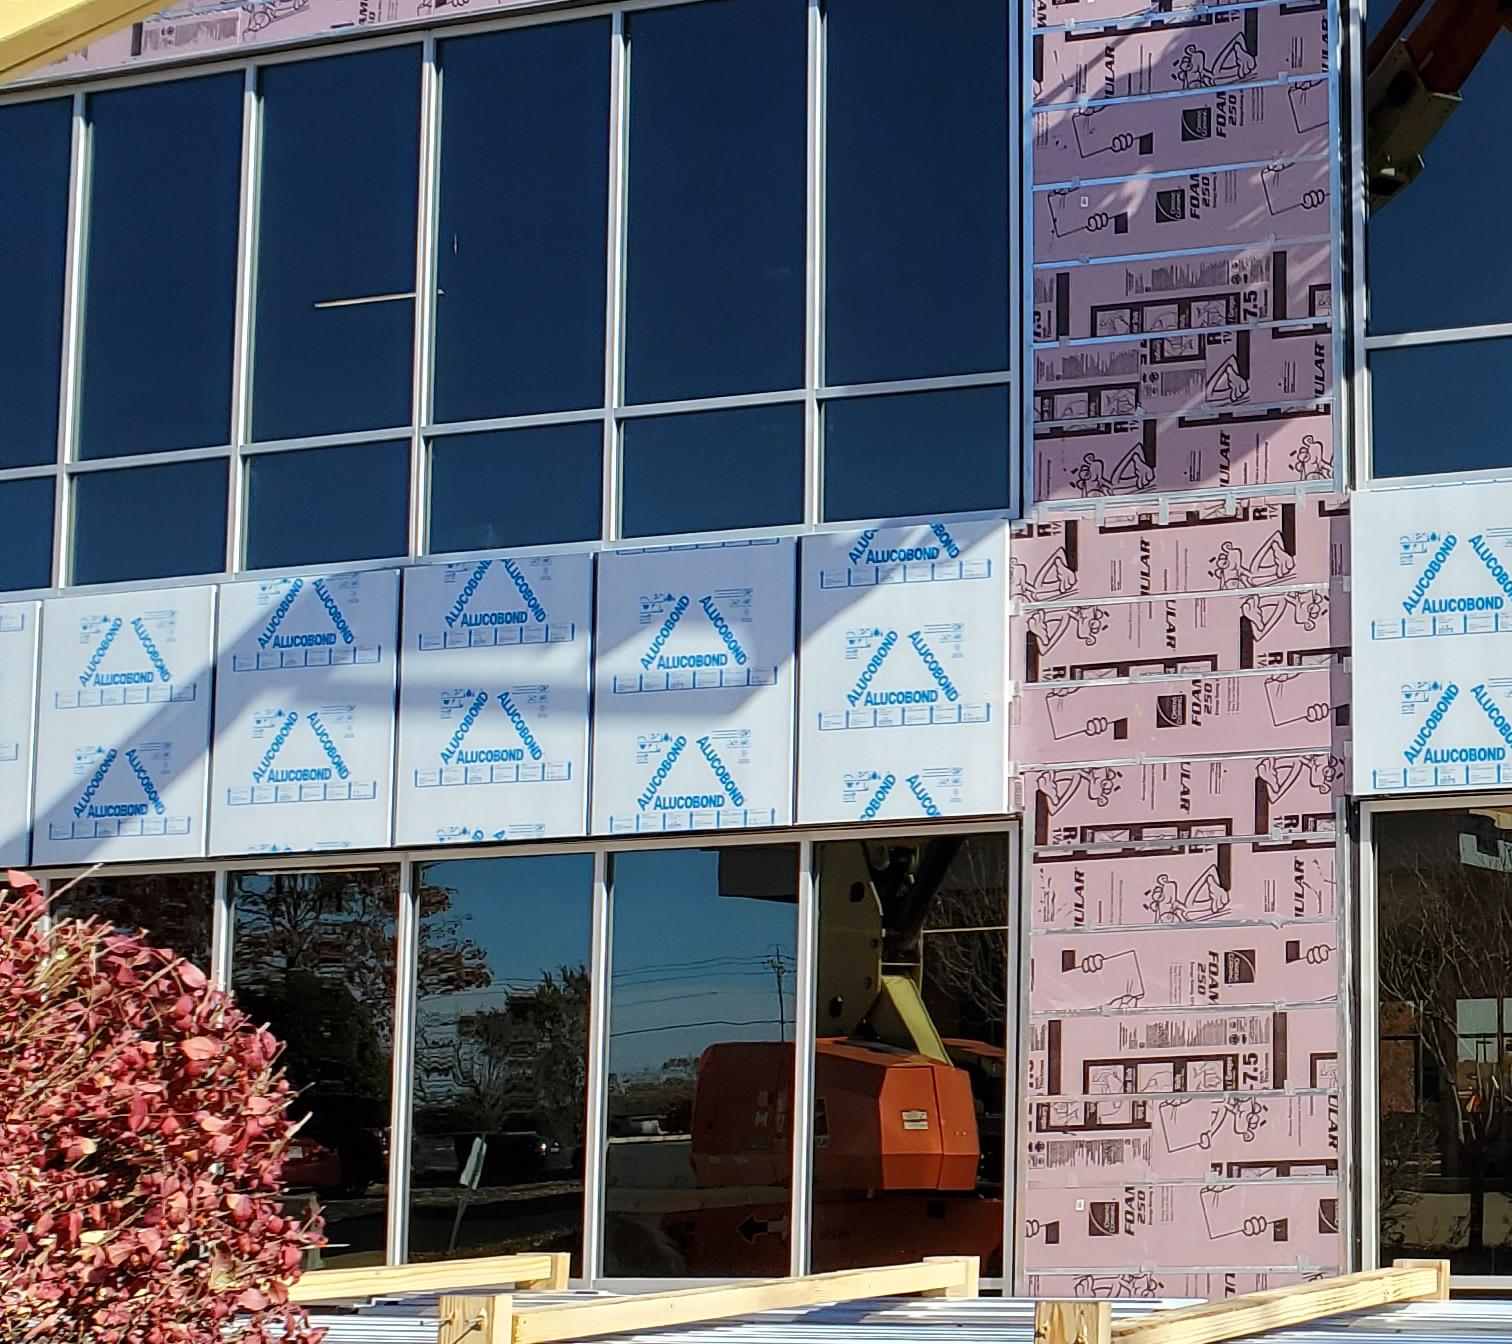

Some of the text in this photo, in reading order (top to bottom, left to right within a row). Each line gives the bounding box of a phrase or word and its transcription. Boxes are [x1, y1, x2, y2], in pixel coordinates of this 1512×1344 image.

[866, 547, 939, 564] ALUCOBOND
[1403, 535, 1456, 614] ALUCOBOND
[258, 582, 301, 649] ALUCOBOND
[313, 579, 354, 644] ALUCOBOND
[461, 611, 527, 627] ALUCOBOND
[641, 594, 690, 669] ALUCOBOND
[699, 595, 746, 665] ALUCOBOND
[1422, 596, 1503, 613] ALUCOBOND
[80, 618, 122, 686] ALUCOBOND
[131, 618, 170, 682] ALUCOBOND
[273, 633, 336, 648] ALUCOBOND
[657, 654, 727, 669] ALUCOBOND
[847, 631, 897, 705] ALUCOBOND
[908, 631, 958, 701] ALUCOBOND
[94, 672, 154, 686] ALUCOBOND
[865, 690, 938, 705] ALUCOBOND
[253, 712, 298, 783] ALUCOBOND
[307, 712, 348, 779] ALUCOBOND
[441, 689, 488, 763] ALUCOBOND
[457, 749, 524, 763] ALUCOBOND
[497, 691, 541, 760] ALUCOBOND
[1404, 684, 1458, 763] ALUCOBOND
[1424, 747, 1505, 763] ALUCOBOND
[74, 749, 117, 818] ALUCOBOND
[125, 749, 164, 813] ALUCOBOND
[267, 768, 331, 782] ALUCOBOND
[637, 736, 686, 809] ALUCOBOND
[654, 795, 724, 810] ALUCOBOND
[697, 737, 744, 807] ALUCOBOND
[88, 804, 147, 818] ALUCOBOND
